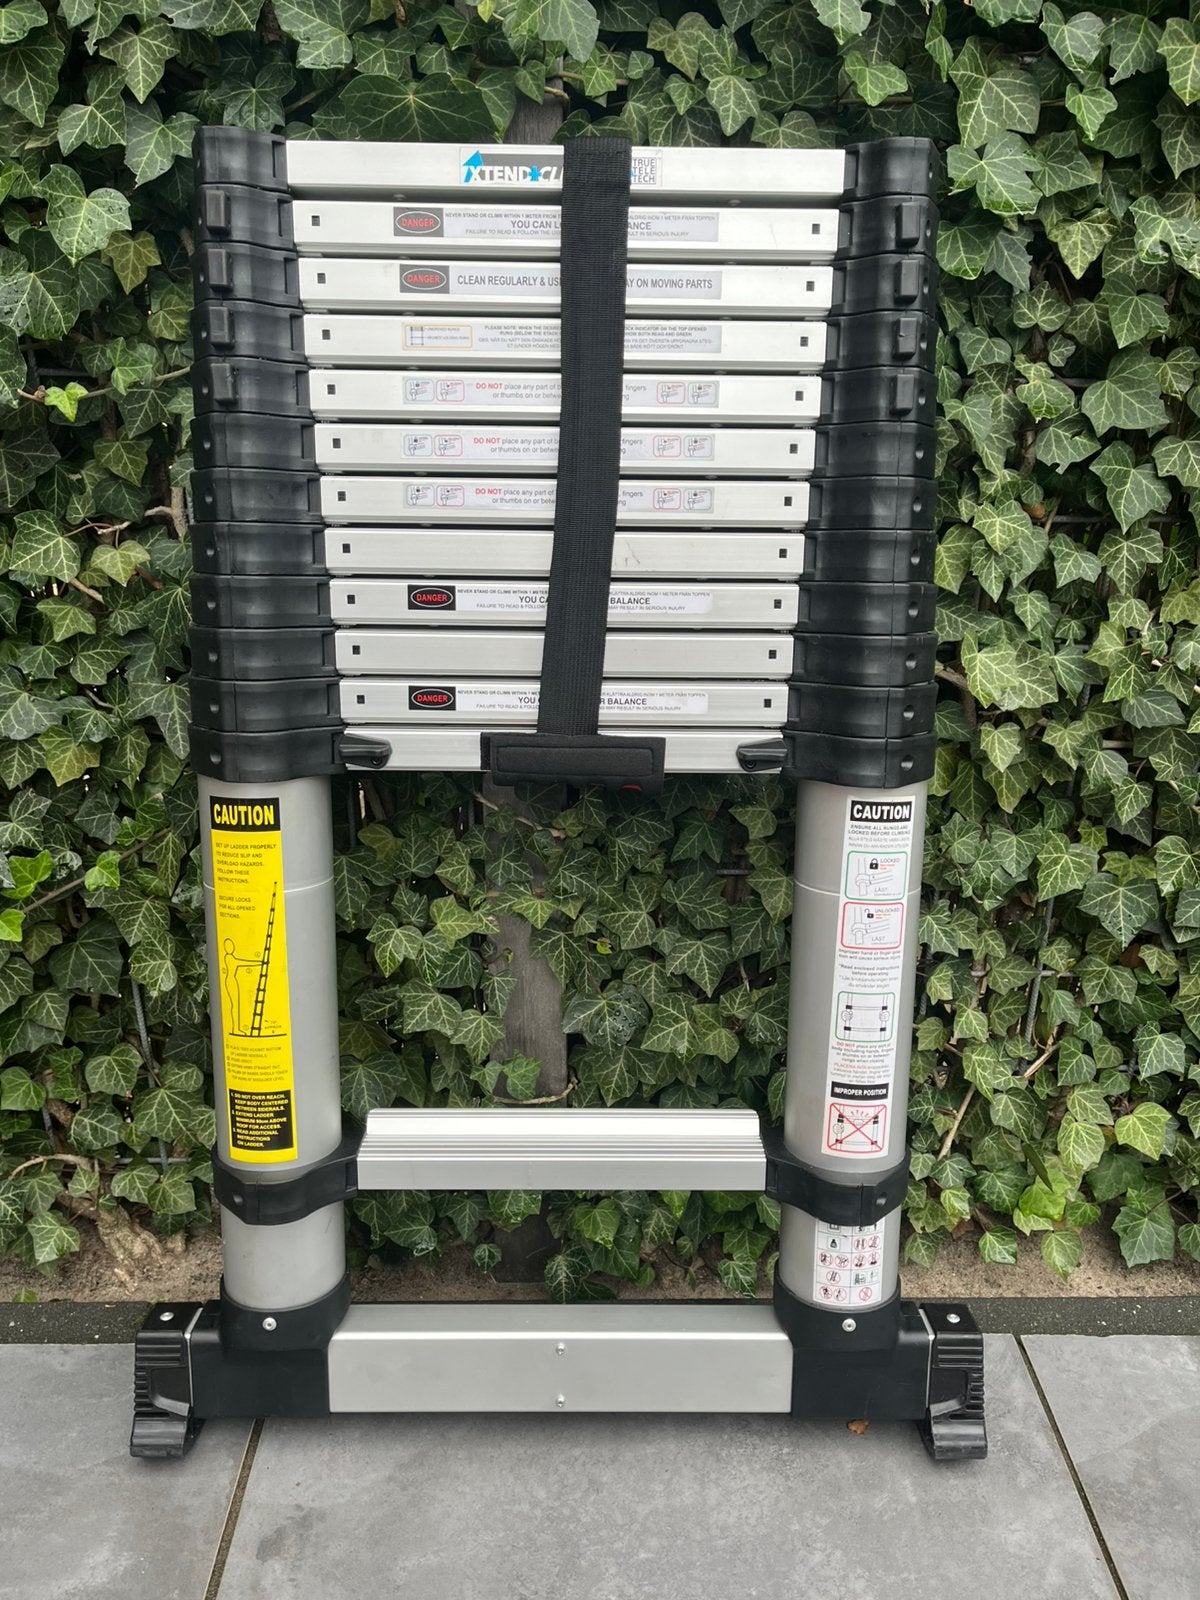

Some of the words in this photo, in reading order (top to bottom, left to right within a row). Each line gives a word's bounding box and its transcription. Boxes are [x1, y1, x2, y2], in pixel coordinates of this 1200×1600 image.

[633, 158, 655, 167] TRUE
[633, 166, 655, 175] TELE
[633, 174, 655, 183] TECH
[400, 218, 435, 227] DANGER
[511, 220, 530, 229] YOU
[532, 220, 552, 229] CAN
[628, 222, 651, 230] ANCE
[407, 275, 440, 284] DANGER
[457, 275, 486, 285] CLEAN
[488, 275, 538, 286] REGULARLY
[539, 276, 546, 287] &
[636, 279, 649, 288] ON
[650, 279, 684, 289] MOVING
[685, 280, 713, 289] PARTS
[504, 383, 521, 392] place
[536, 384, 548, 392] part
[625, 384, 647, 393] fingers
[501, 391, 523, 399] thumbs
[502, 438, 519, 446] place
[520, 439, 532, 447] any
[533, 438, 546, 447] part
[622, 438, 643, 446] fingers
[504, 489, 521, 497] place
[416, 594, 448, 602] DANGER
[610, 597, 651, 605] BALANCE
[416, 694, 448, 702] DANGER
[518, 696, 536, 704] YOU
[607, 697, 648, 705] BALANCE
[213, 803, 275, 826] CAUTION
[853, 804, 910, 820] CAUTION
[217, 859, 239, 867] OVERLOAD
[833, 1087, 863, 1096] IMPROPER
[863, 1088, 887, 1096] POSITION
[235, 1104, 257, 1112] BETWEEN
[237, 1134, 271, 1142] INSTRUCTIONS
